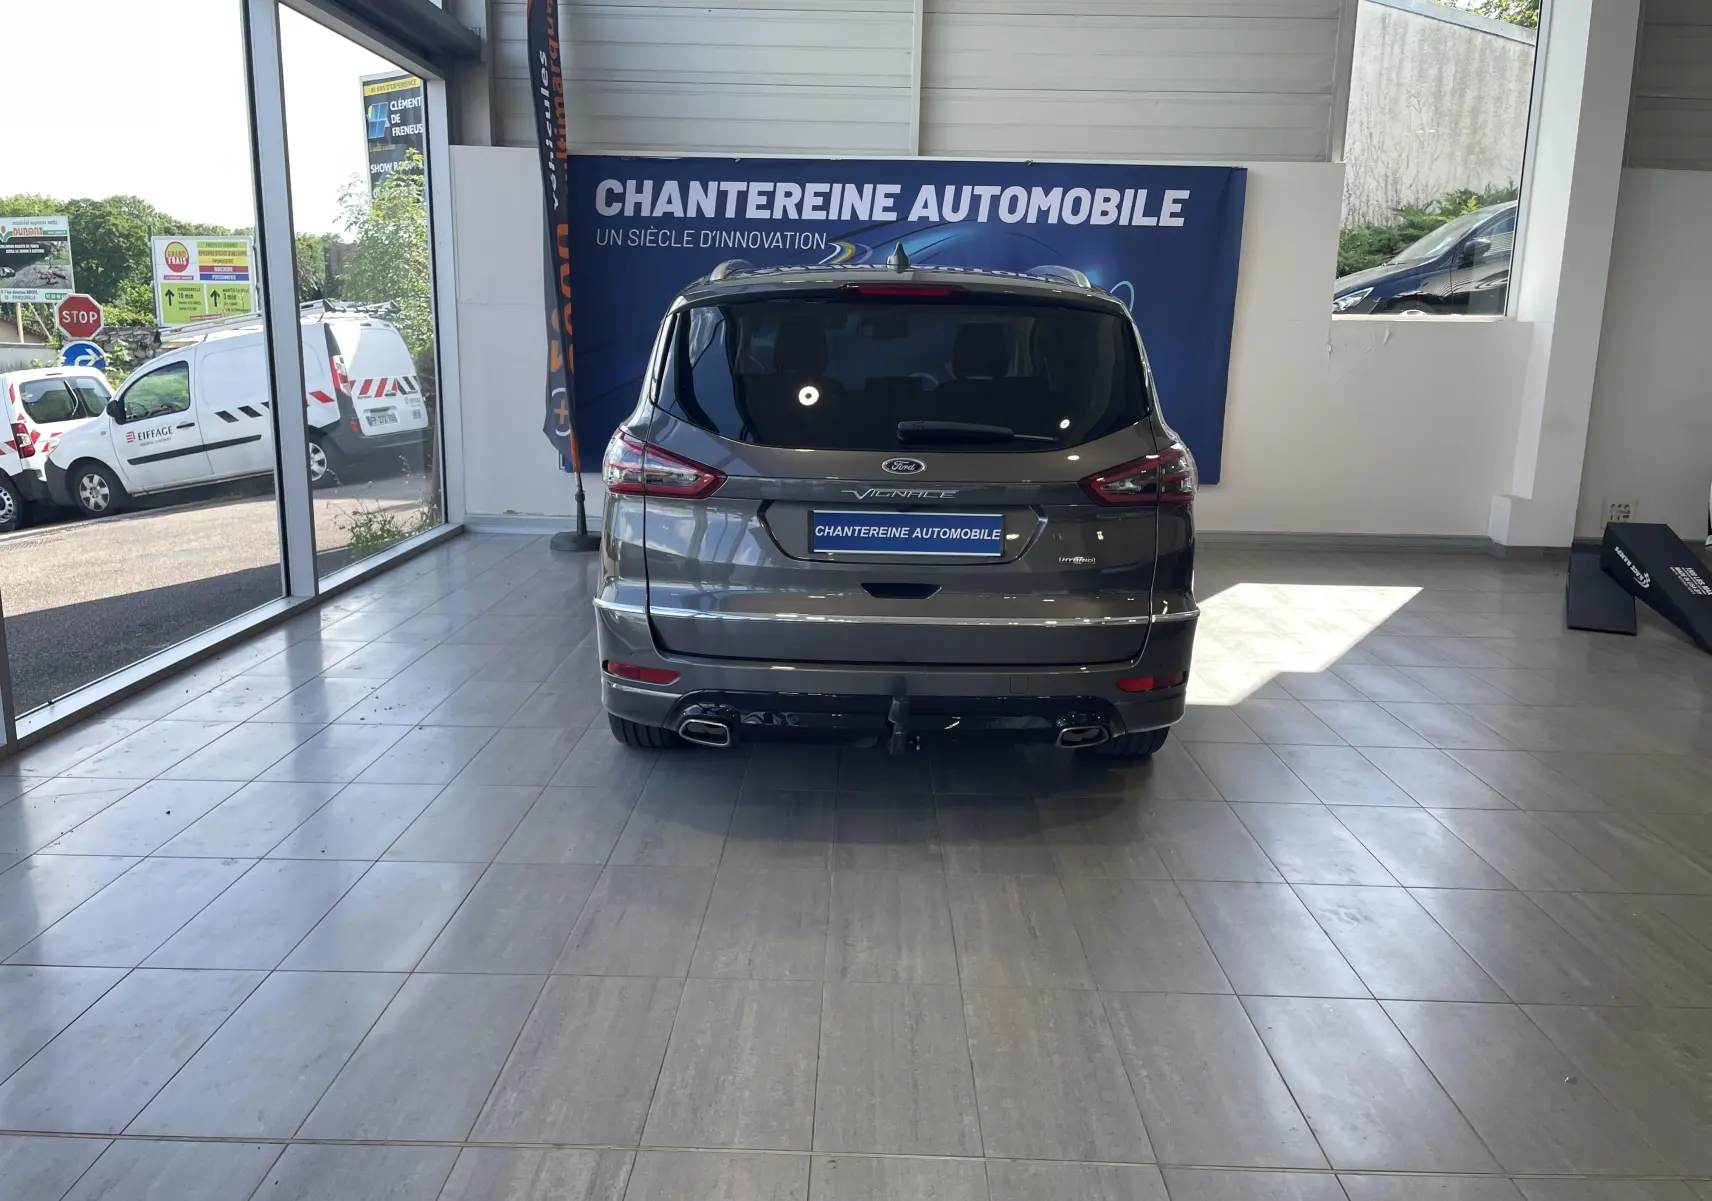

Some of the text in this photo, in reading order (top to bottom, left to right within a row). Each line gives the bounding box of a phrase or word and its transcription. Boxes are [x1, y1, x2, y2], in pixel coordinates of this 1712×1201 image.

[391, 113, 401, 123] DE
[370, 161, 392, 174] SHOW
[595, 178, 1191, 227] CHANTEREINE AUTOMOBILE
[596, 226, 827, 250] UN SIÈCLE D'INNOVATION
[167, 257, 187, 265] FRAIS
[62, 310, 98, 324] STOP
[137, 425, 173, 441] EIFFAGE
[891, 460, 916, 472] Ford
[841, 488, 959, 500] VIGNALE
[814, 525, 1001, 540] CHANTEREINE AUTOMOBILE
